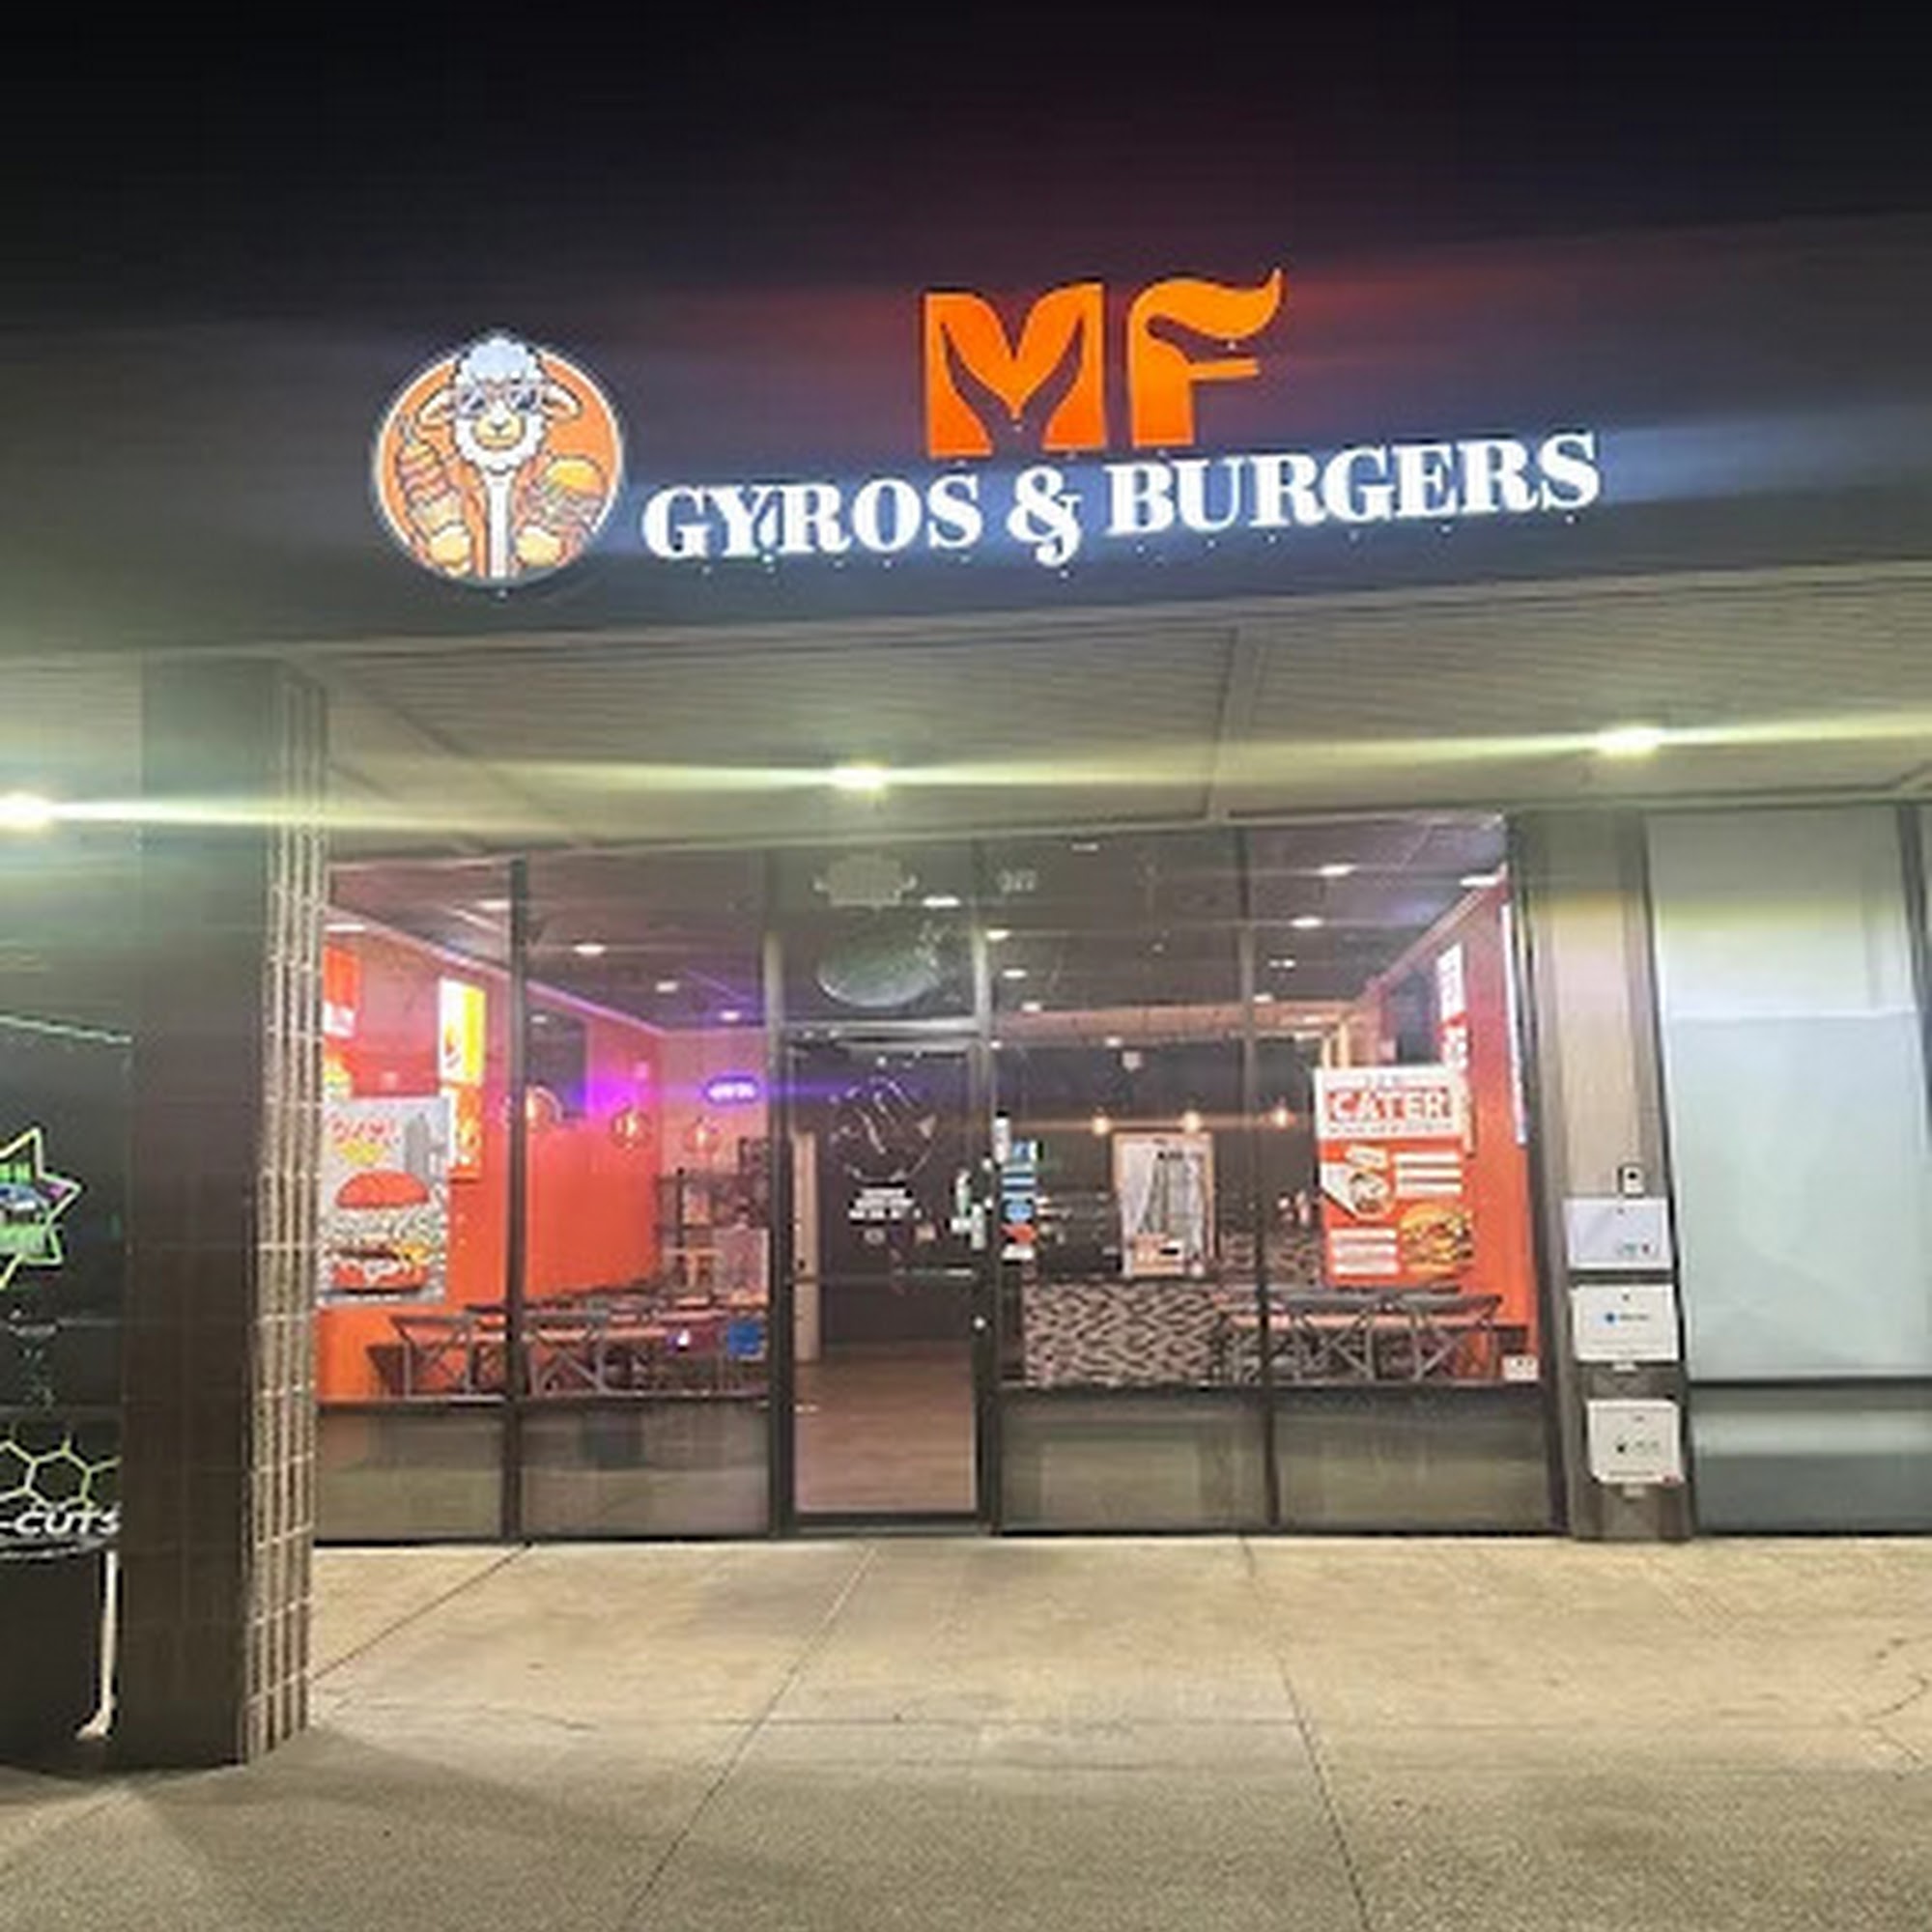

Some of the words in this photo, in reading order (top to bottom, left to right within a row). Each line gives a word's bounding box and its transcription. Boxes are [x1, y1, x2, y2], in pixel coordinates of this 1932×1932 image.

[923, 268, 1284, 458] MF
[642, 474, 983, 559] GYROS
[1007, 465, 1083, 566] &
[1103, 433, 1601, 536] BURGERS
[1332, 1088, 1448, 1123] CATER
